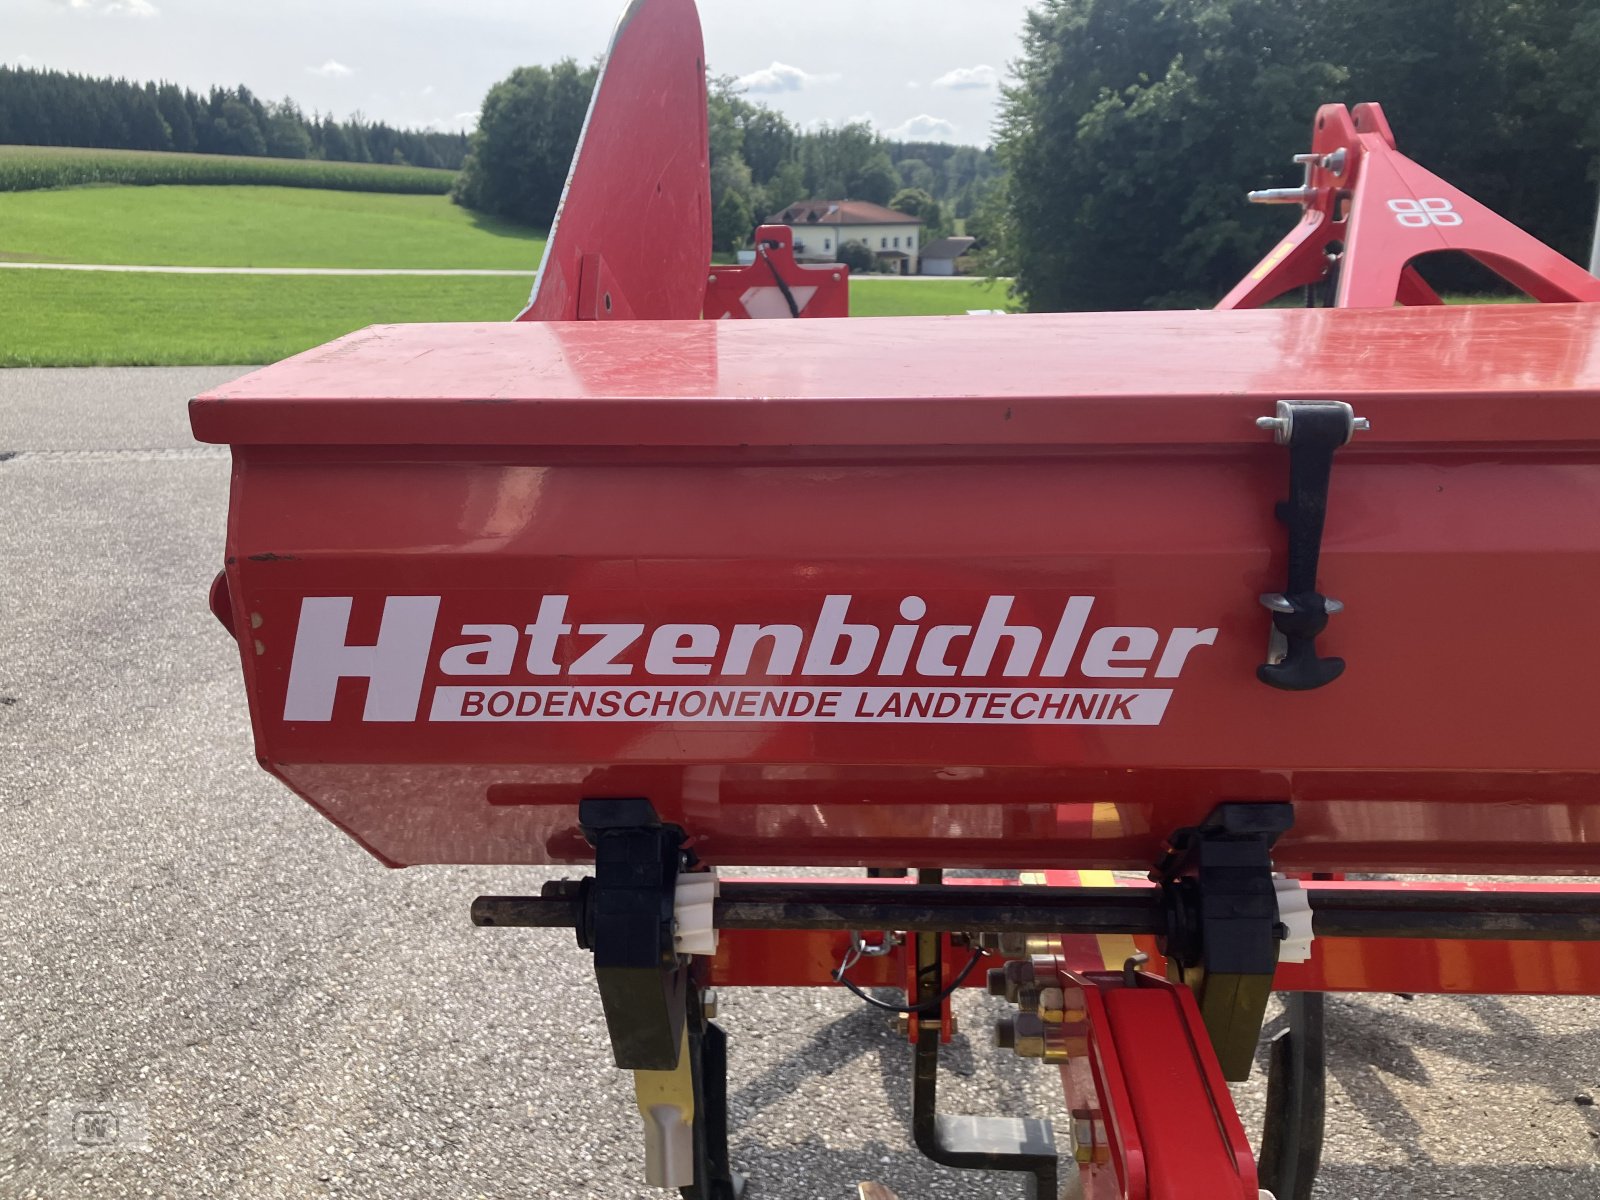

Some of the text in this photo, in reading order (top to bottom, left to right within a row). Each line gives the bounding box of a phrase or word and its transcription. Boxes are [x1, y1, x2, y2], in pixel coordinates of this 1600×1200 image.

[282, 594, 1219, 722] Hatzenbichler
[461, 690, 1140, 721] BODENSCHONENDE LANDTECHNIK
